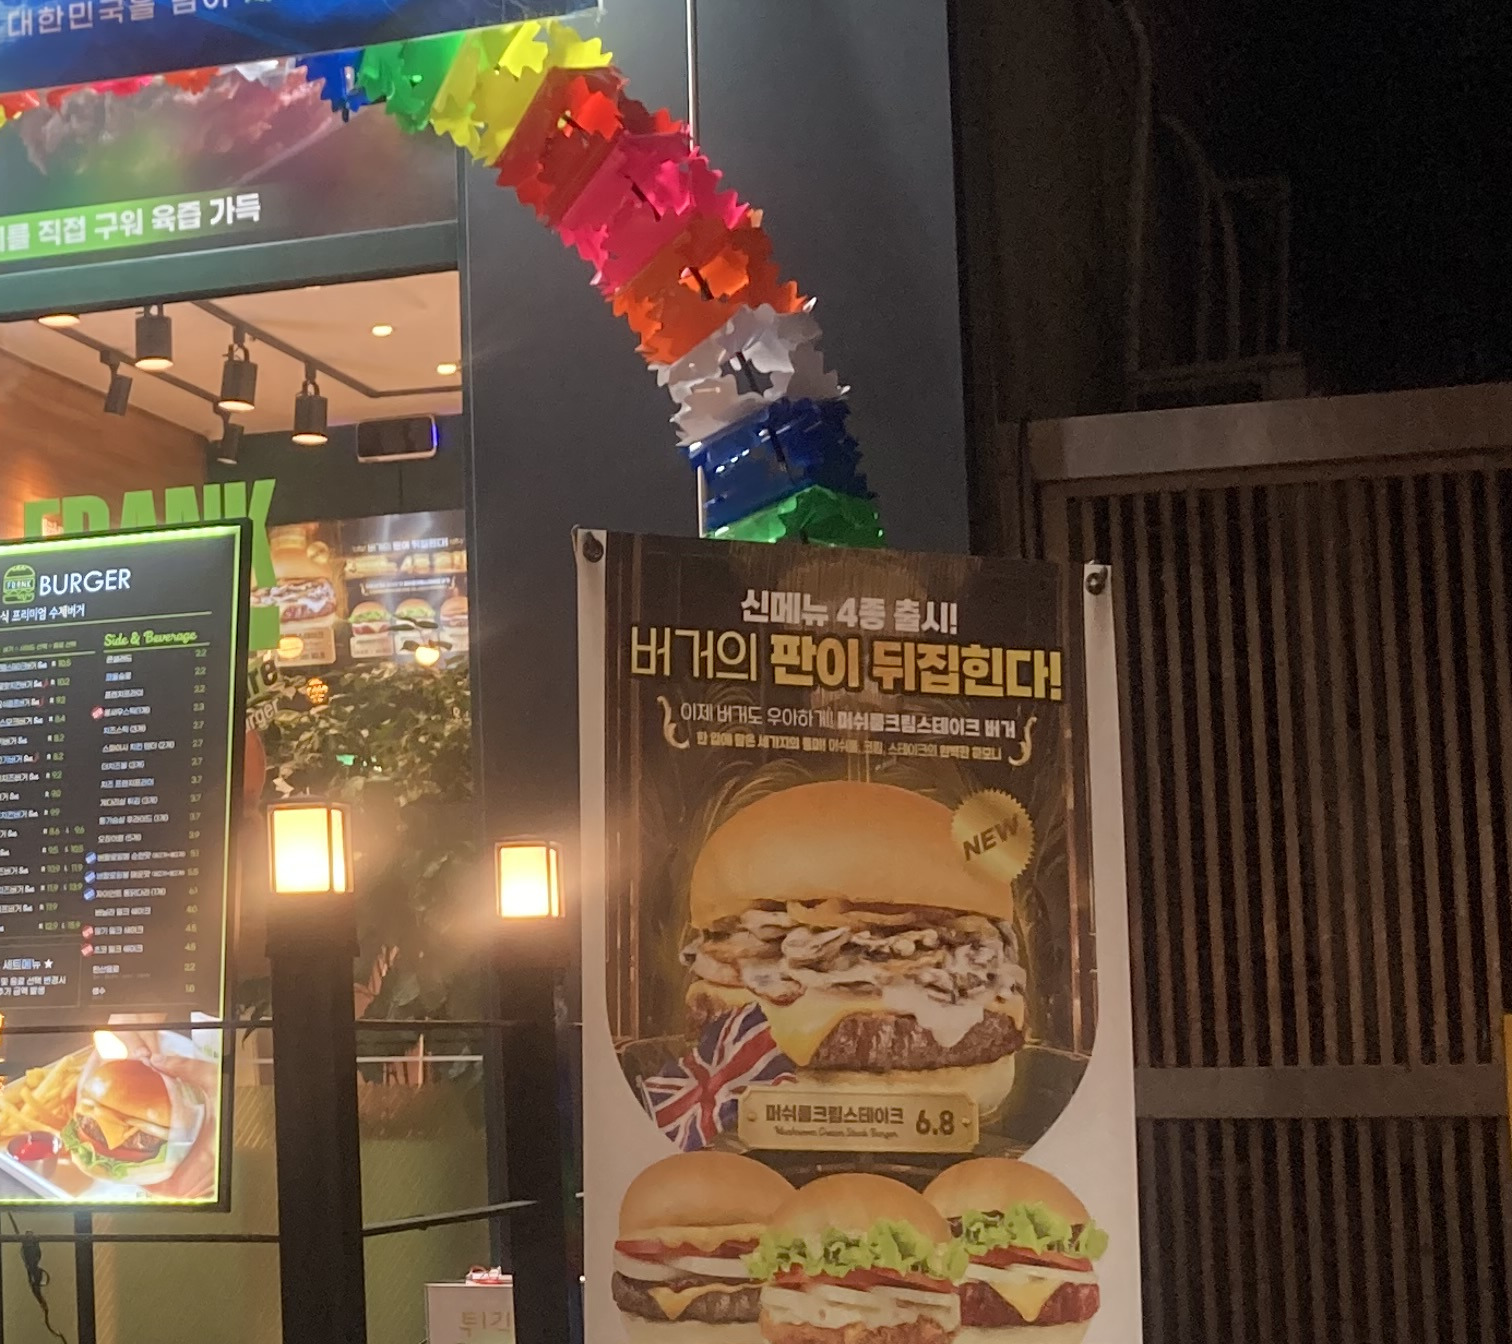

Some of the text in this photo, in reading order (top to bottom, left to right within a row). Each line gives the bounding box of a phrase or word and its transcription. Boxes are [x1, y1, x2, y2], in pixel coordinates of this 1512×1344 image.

[38, 216, 87, 246] 직접
[94, 207, 144, 242] 구워
[152, 201, 202, 234] 육즙
[210, 192, 261, 225] 가득
[39, 568, 132, 597] BURGER
[11, 606, 47, 622] 프리미엄
[49, 603, 86, 620] 수제버거
[740, 588, 958, 635] 신메뉴 4종 출시!
[104, 633, 129, 647] Side
[143, 630, 198, 645] Beverage
[630, 627, 1062, 701] 버거의 판이 뒤집힌다!
[680, 701, 713, 723] 이제
[717, 703, 763, 726] 버거도
[838, 711, 980, 737] 머쉬룸크림스테이크
[985, 715, 1015, 739] 버거
[962, 815, 1021, 862] NEW
[766, 1104, 904, 1124] 머쉬룸크림스테이크
[916, 1109, 955, 1136] 6.8
